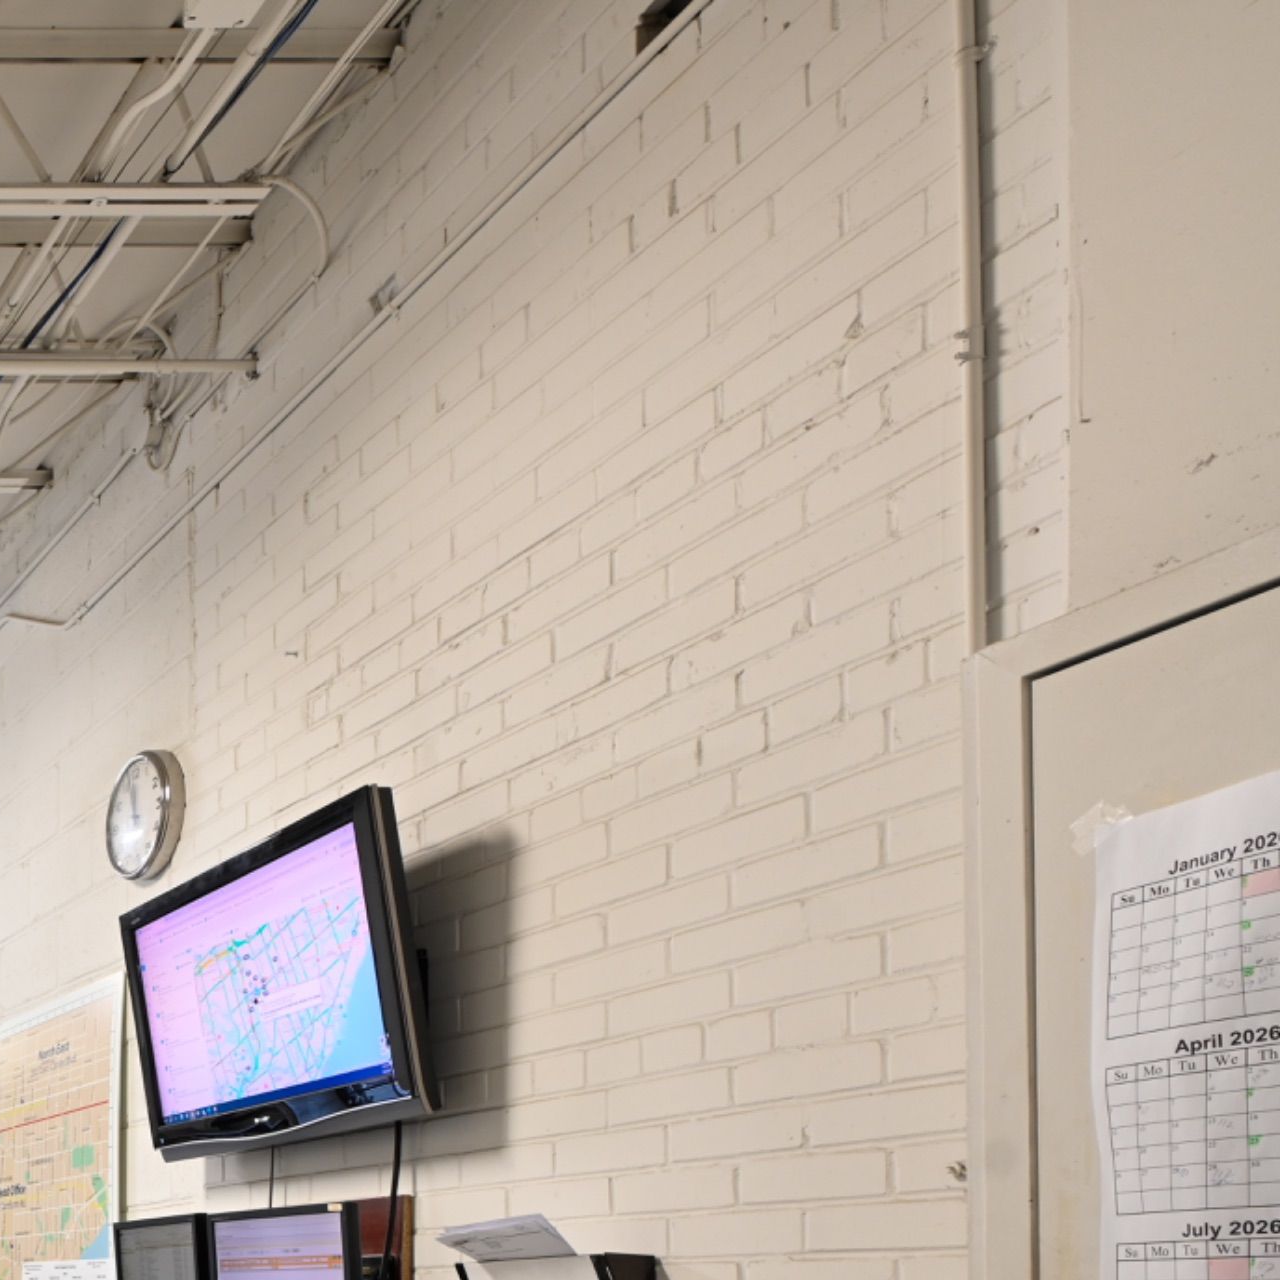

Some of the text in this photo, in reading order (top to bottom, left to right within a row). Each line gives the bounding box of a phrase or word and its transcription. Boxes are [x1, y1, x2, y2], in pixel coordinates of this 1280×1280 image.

[1168, 832, 1280, 875] January 202
[1150, 886, 1170, 897] Mo
[1183, 877, 1200, 888] Tu
[1214, 867, 1235, 879] We
[1250, 857, 1271, 870] Th
[1175, 1025, 1280, 1056] April 2026
[1114, 1049, 1279, 1081] Su Mo Tu We Th
[1182, 1220, 1280, 1240] July 2026
[1151, 1246, 1169, 1257] Mo
[1183, 1244, 1198, 1256] Tu
[1216, 1243, 1241, 1255] We
[1260, 1241, 1280, 1254] Th
